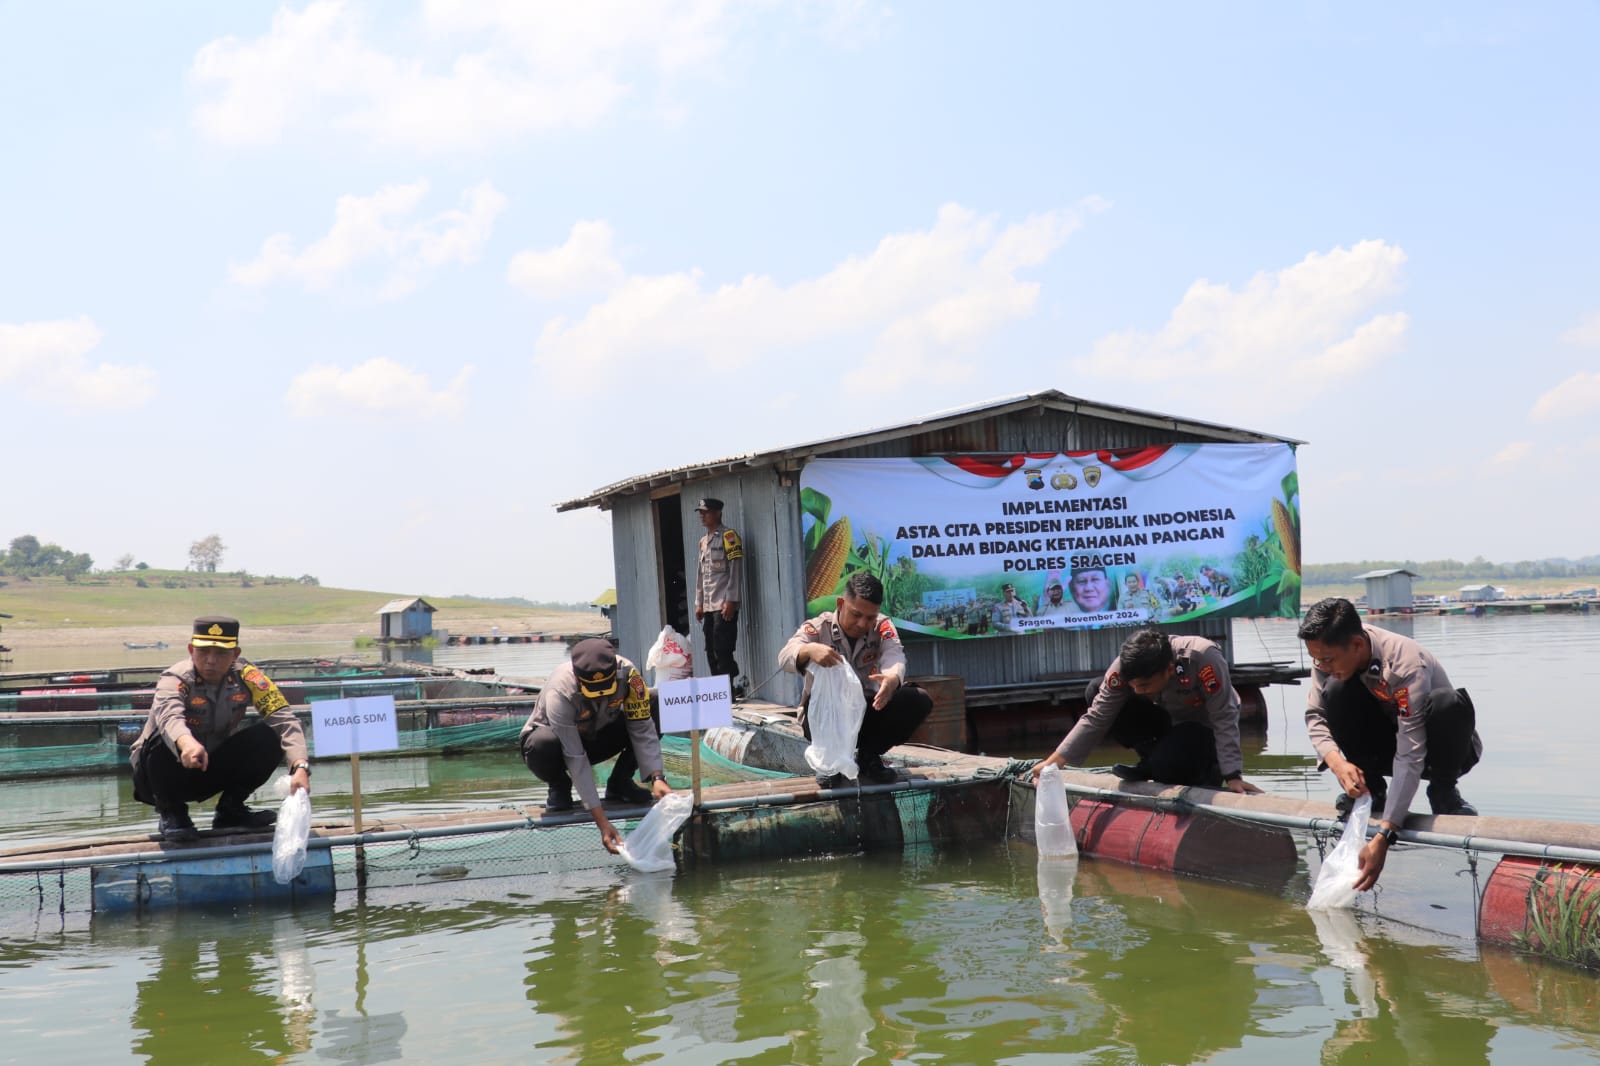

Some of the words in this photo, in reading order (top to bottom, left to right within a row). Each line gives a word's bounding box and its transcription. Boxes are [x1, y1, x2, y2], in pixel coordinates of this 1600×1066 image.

[1002, 497, 1127, 516] IMPLEMENTASI
[896, 525, 941, 540] ASTA
[944, 523, 981, 538] CITA
[985, 519, 1062, 535] PRESIDEN
[1065, 515, 1139, 532] REPUBLIK
[1143, 508, 1236, 527] INDONESIA
[912, 542, 975, 558] DALAM
[979, 539, 1042, 555] BIDANG
[1046, 533, 1148, 551] KETAHANAN
[1152, 527, 1225, 545] PANGAN
[1003, 556, 1066, 572] POLRES
[1070, 552, 1136, 568] SRAGEN
[1018, 618, 1055, 627] Sragen,
[1064, 613, 1114, 624] November
[1116, 611, 1139, 619] 2024
[664, 695, 694, 706] WAKA
[696, 690, 728, 703] POLRES
[324, 715, 361, 727] KABAG
[363, 713, 387, 724] SDM
